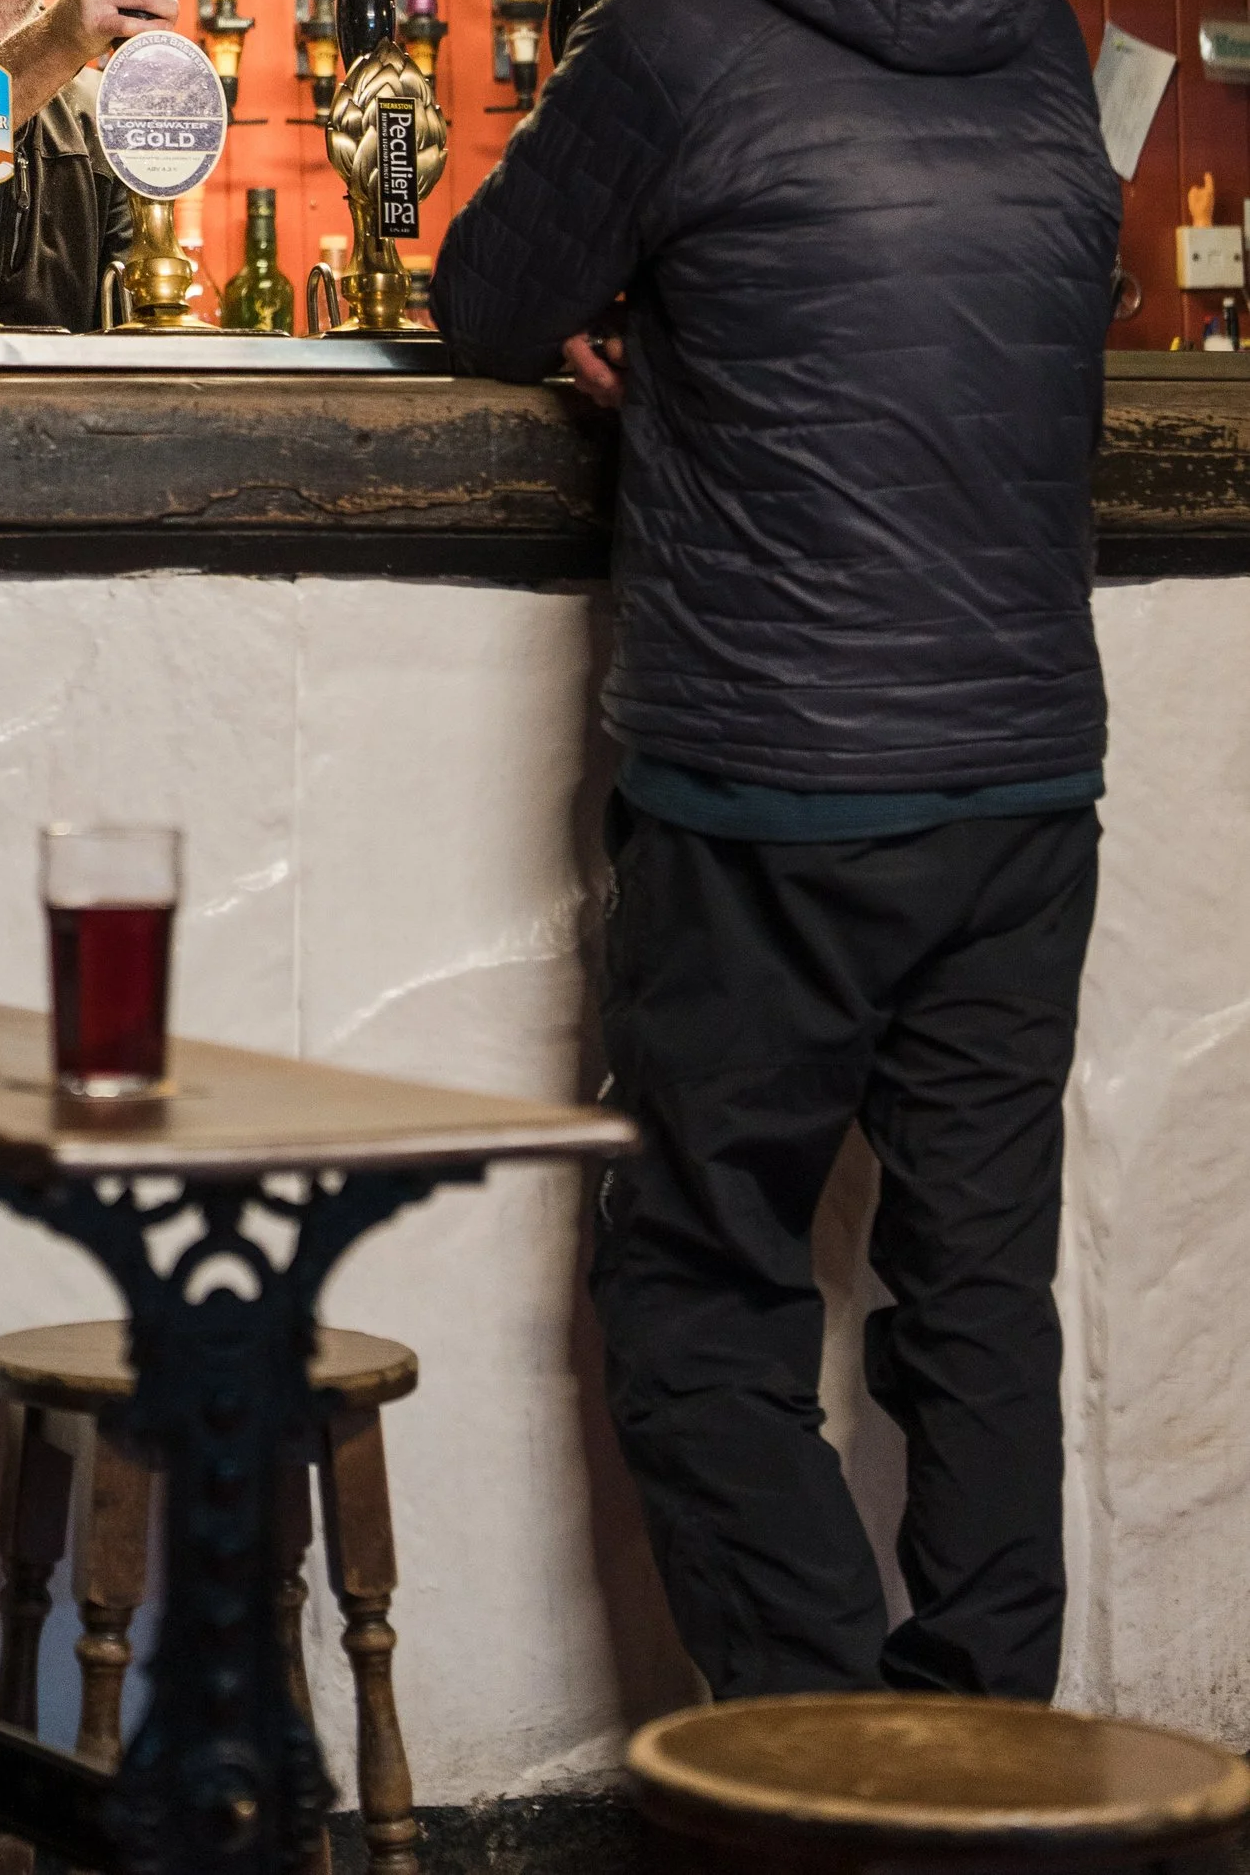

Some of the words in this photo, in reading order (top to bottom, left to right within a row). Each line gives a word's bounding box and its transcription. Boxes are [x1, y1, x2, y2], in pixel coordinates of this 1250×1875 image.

[108, 35, 168, 76] LOWESWATER
[379, 102, 414, 110] THEAKSTON
[116, 120, 210, 130] LOWESWATER
[125, 128, 196, 150] GOLD
[388, 112, 414, 201] Peculier
